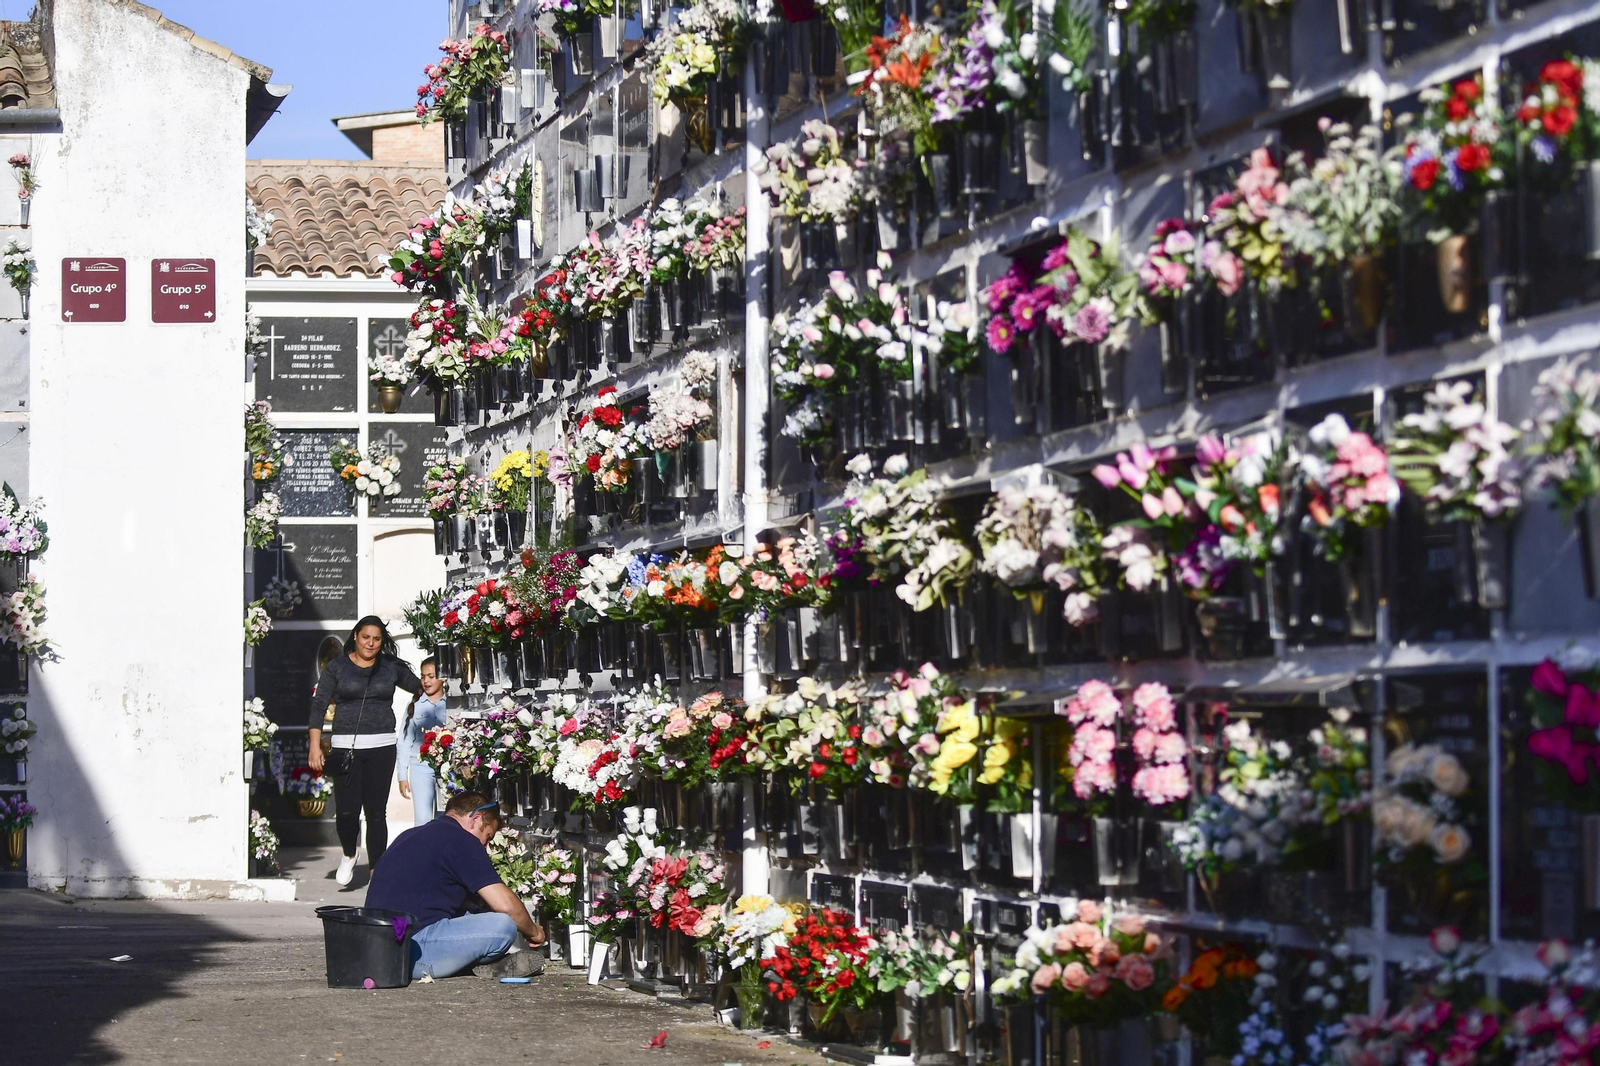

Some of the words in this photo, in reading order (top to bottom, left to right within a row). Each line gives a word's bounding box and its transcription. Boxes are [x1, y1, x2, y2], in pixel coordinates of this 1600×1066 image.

[70, 283, 102, 295] Grupo
[104, 283, 117, 293] 4º
[160, 284, 192, 296] Grupo
[194, 284, 207, 294] 5º
[321, 546, 346, 556] Rafaela
